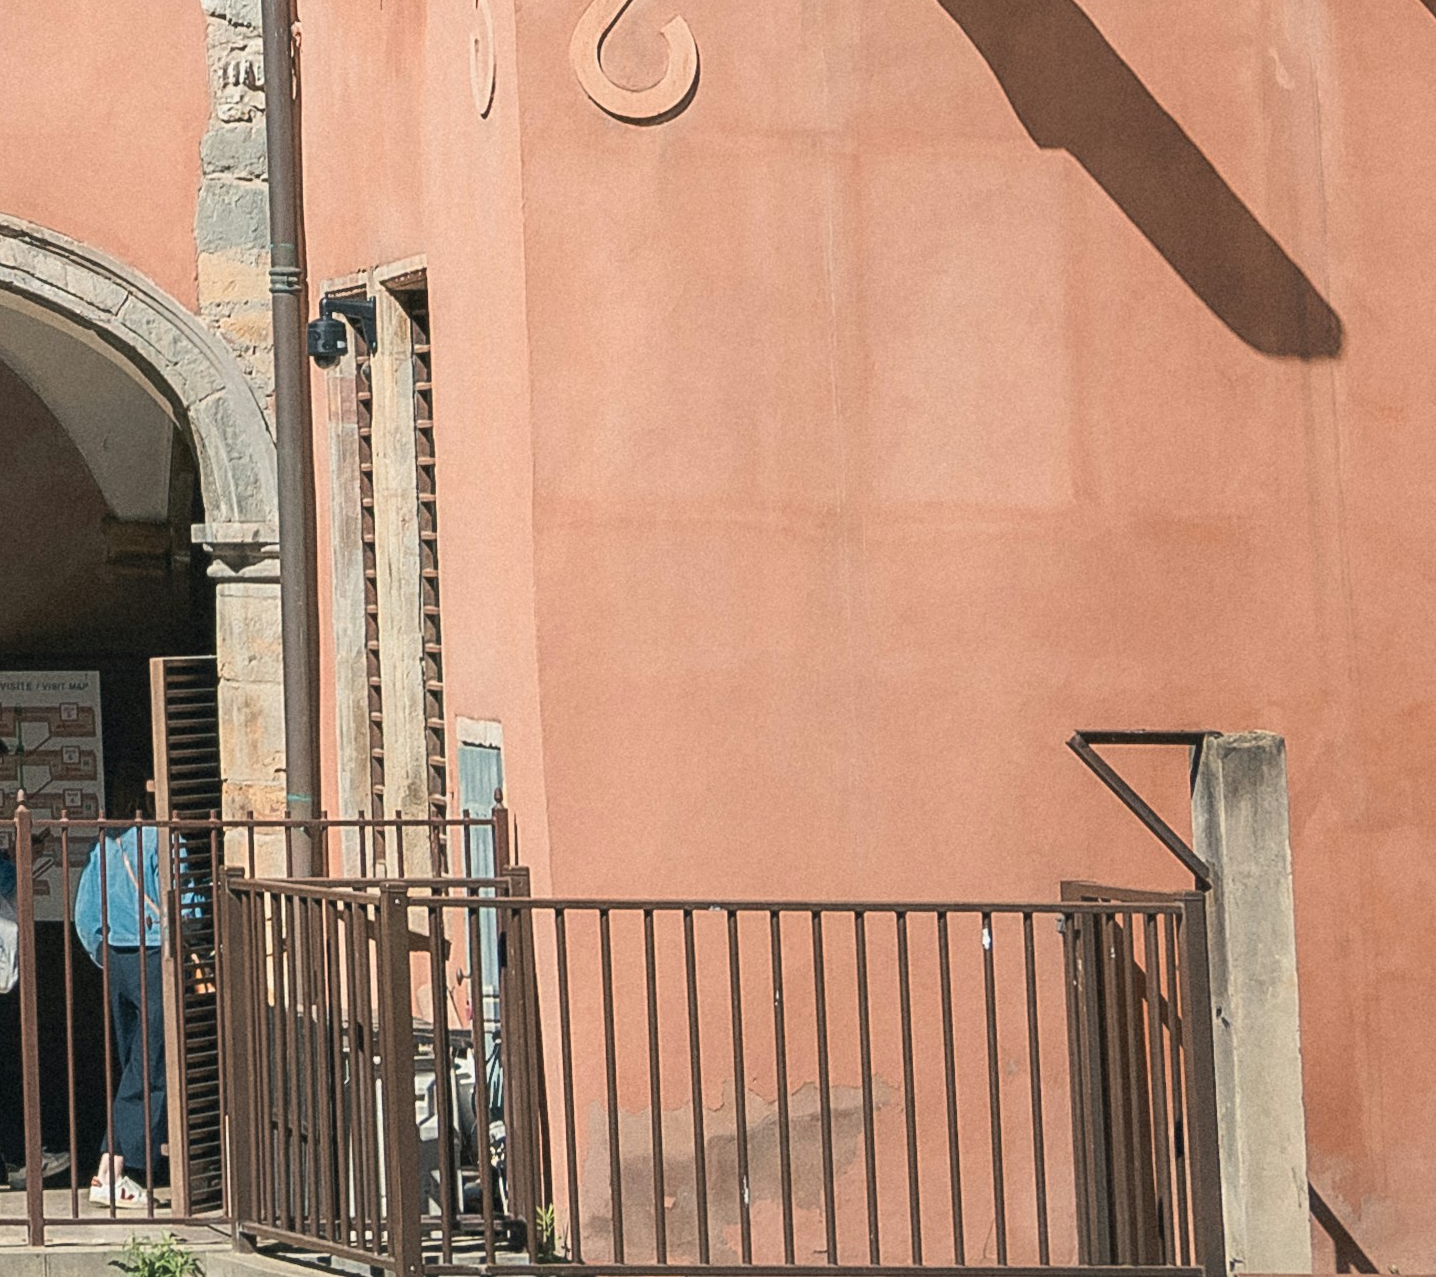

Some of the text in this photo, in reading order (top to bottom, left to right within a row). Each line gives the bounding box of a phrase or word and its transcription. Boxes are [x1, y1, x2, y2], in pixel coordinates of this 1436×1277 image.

[0, 681, 32, 691] VISITE
[42, 682, 66, 691] VISIT
[69, 682, 89, 691] MAP
